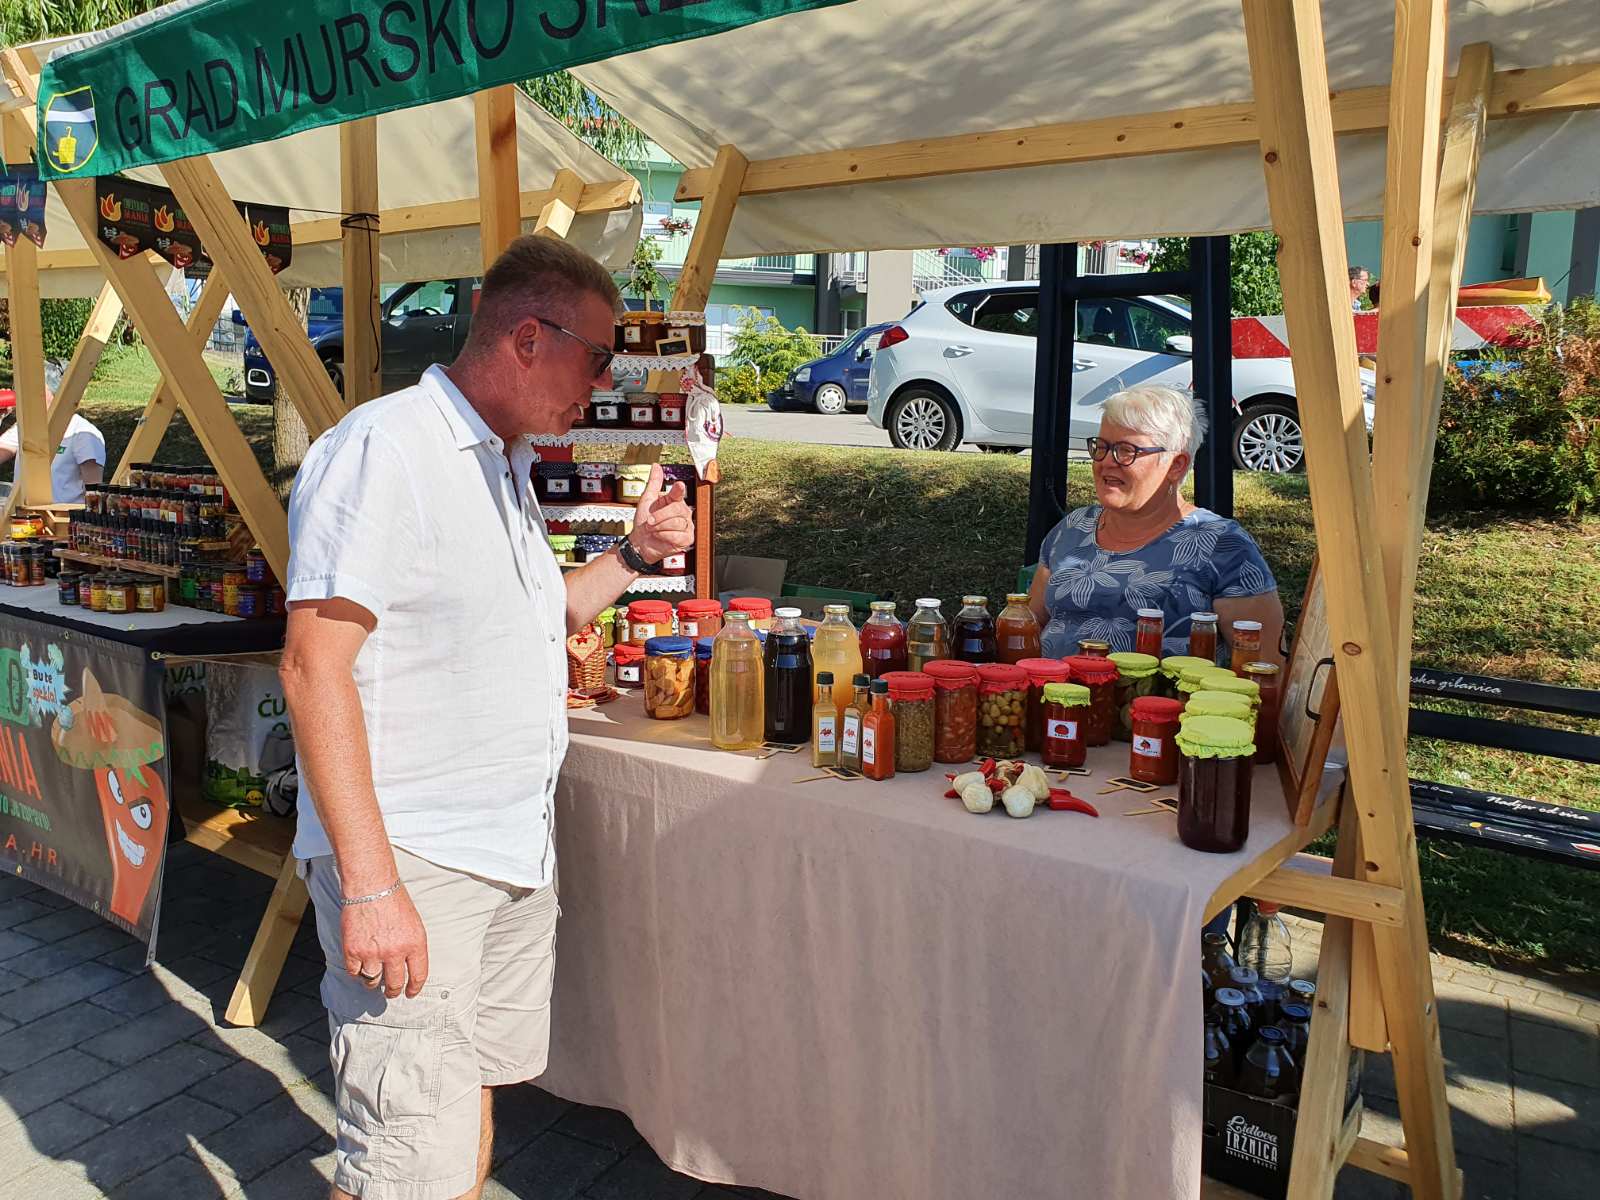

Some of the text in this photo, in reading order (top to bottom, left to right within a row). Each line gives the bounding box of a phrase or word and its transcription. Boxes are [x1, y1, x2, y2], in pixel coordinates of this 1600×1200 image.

[114, 0, 514, 151] GRAD MURSKO
[1226, 1115, 1278, 1143] Lidlova
